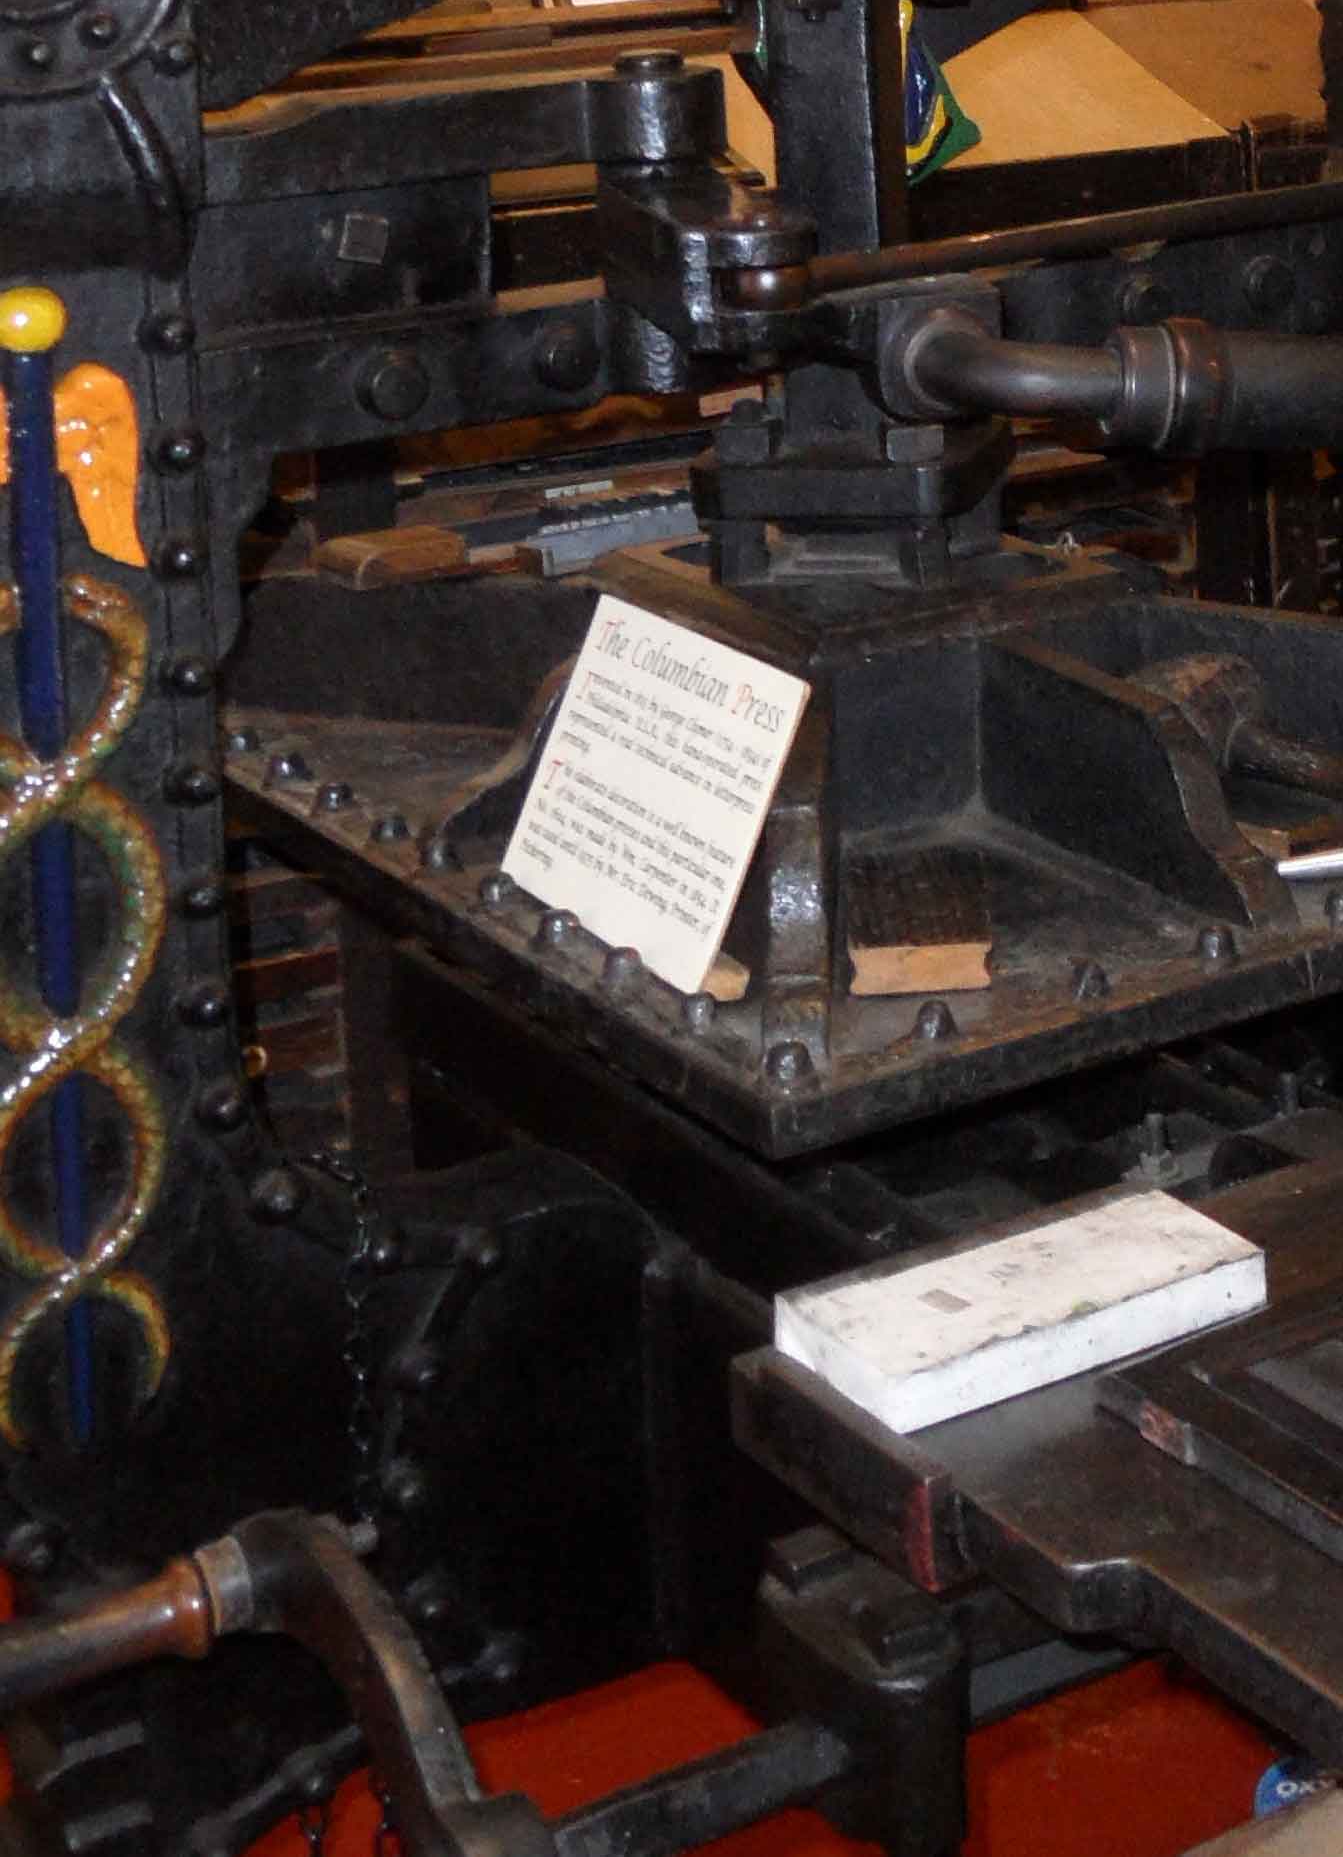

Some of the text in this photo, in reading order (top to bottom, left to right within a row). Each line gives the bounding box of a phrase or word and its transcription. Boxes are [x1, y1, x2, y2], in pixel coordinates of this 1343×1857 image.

[594, 615, 786, 735] The Columbian Press
